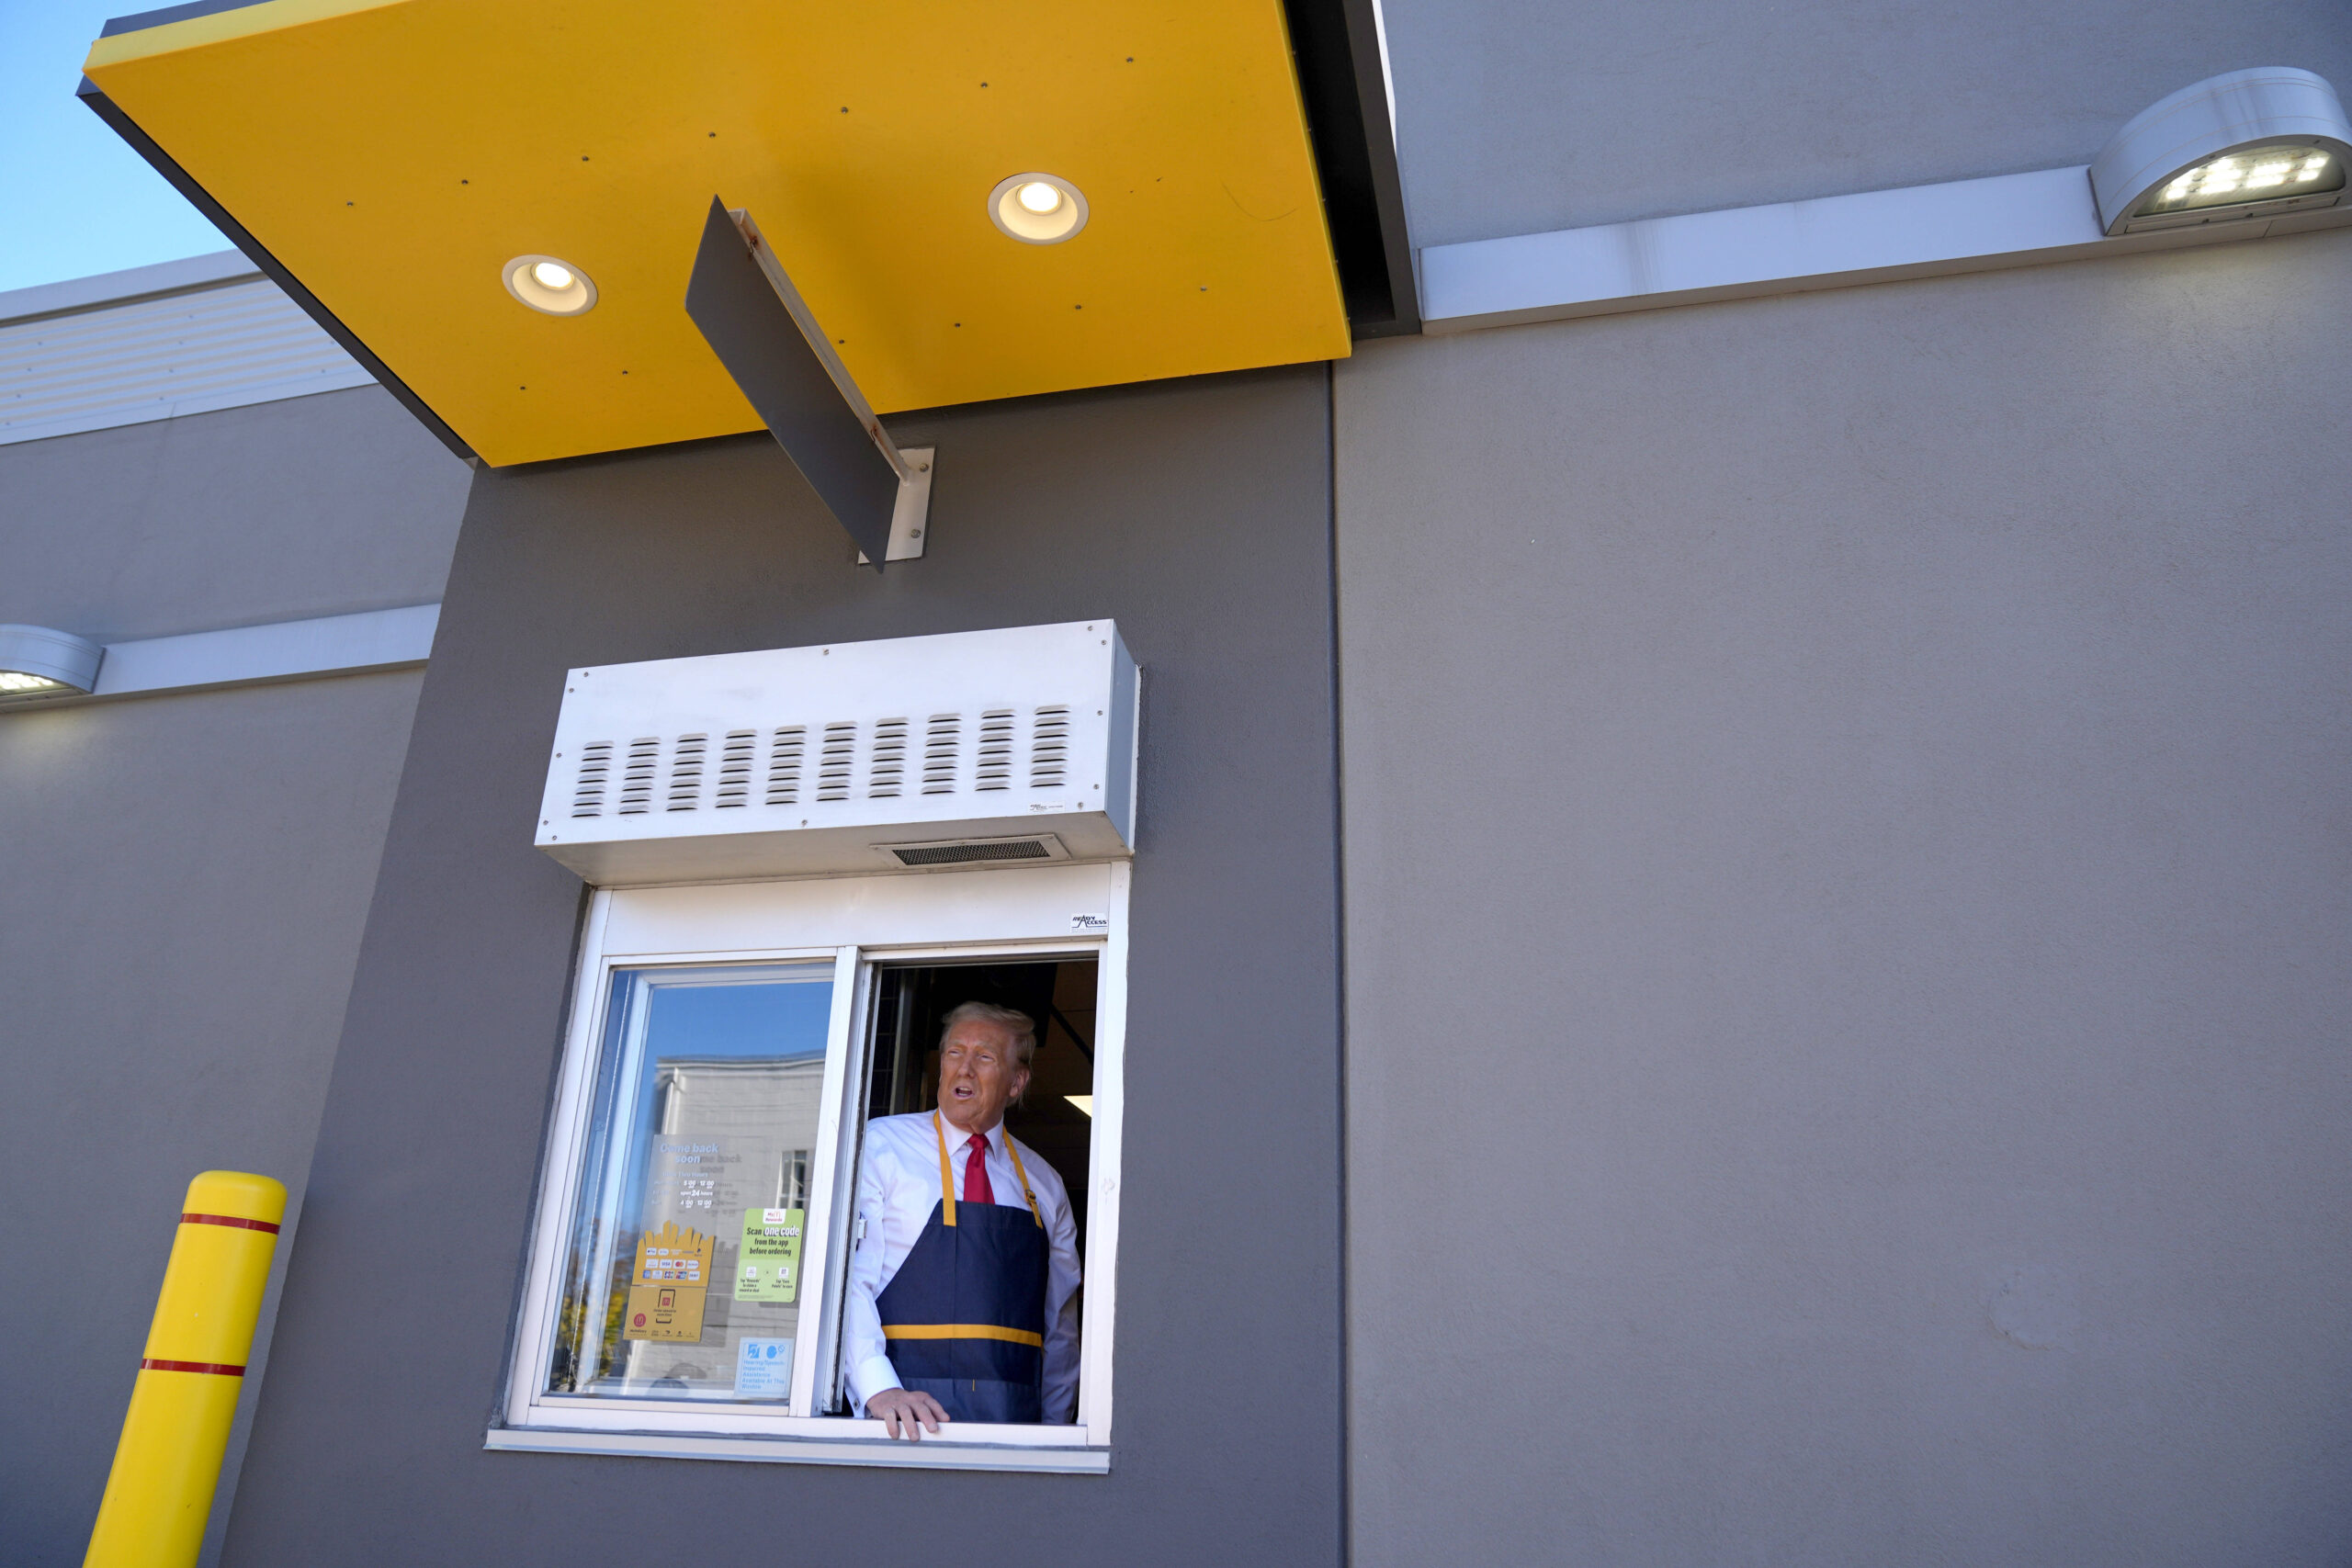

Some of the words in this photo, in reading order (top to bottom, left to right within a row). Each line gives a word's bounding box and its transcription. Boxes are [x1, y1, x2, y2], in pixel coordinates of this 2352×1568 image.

[661, 1143, 690, 1153] Come
[693, 1143, 718, 1153] back
[675, 1156, 701, 1164] soon
[747, 1227, 762, 1235] Scan
[763, 1227, 779, 1236] one
[779, 1225, 799, 1236] code
[768, 1248, 792, 1257] ordering
